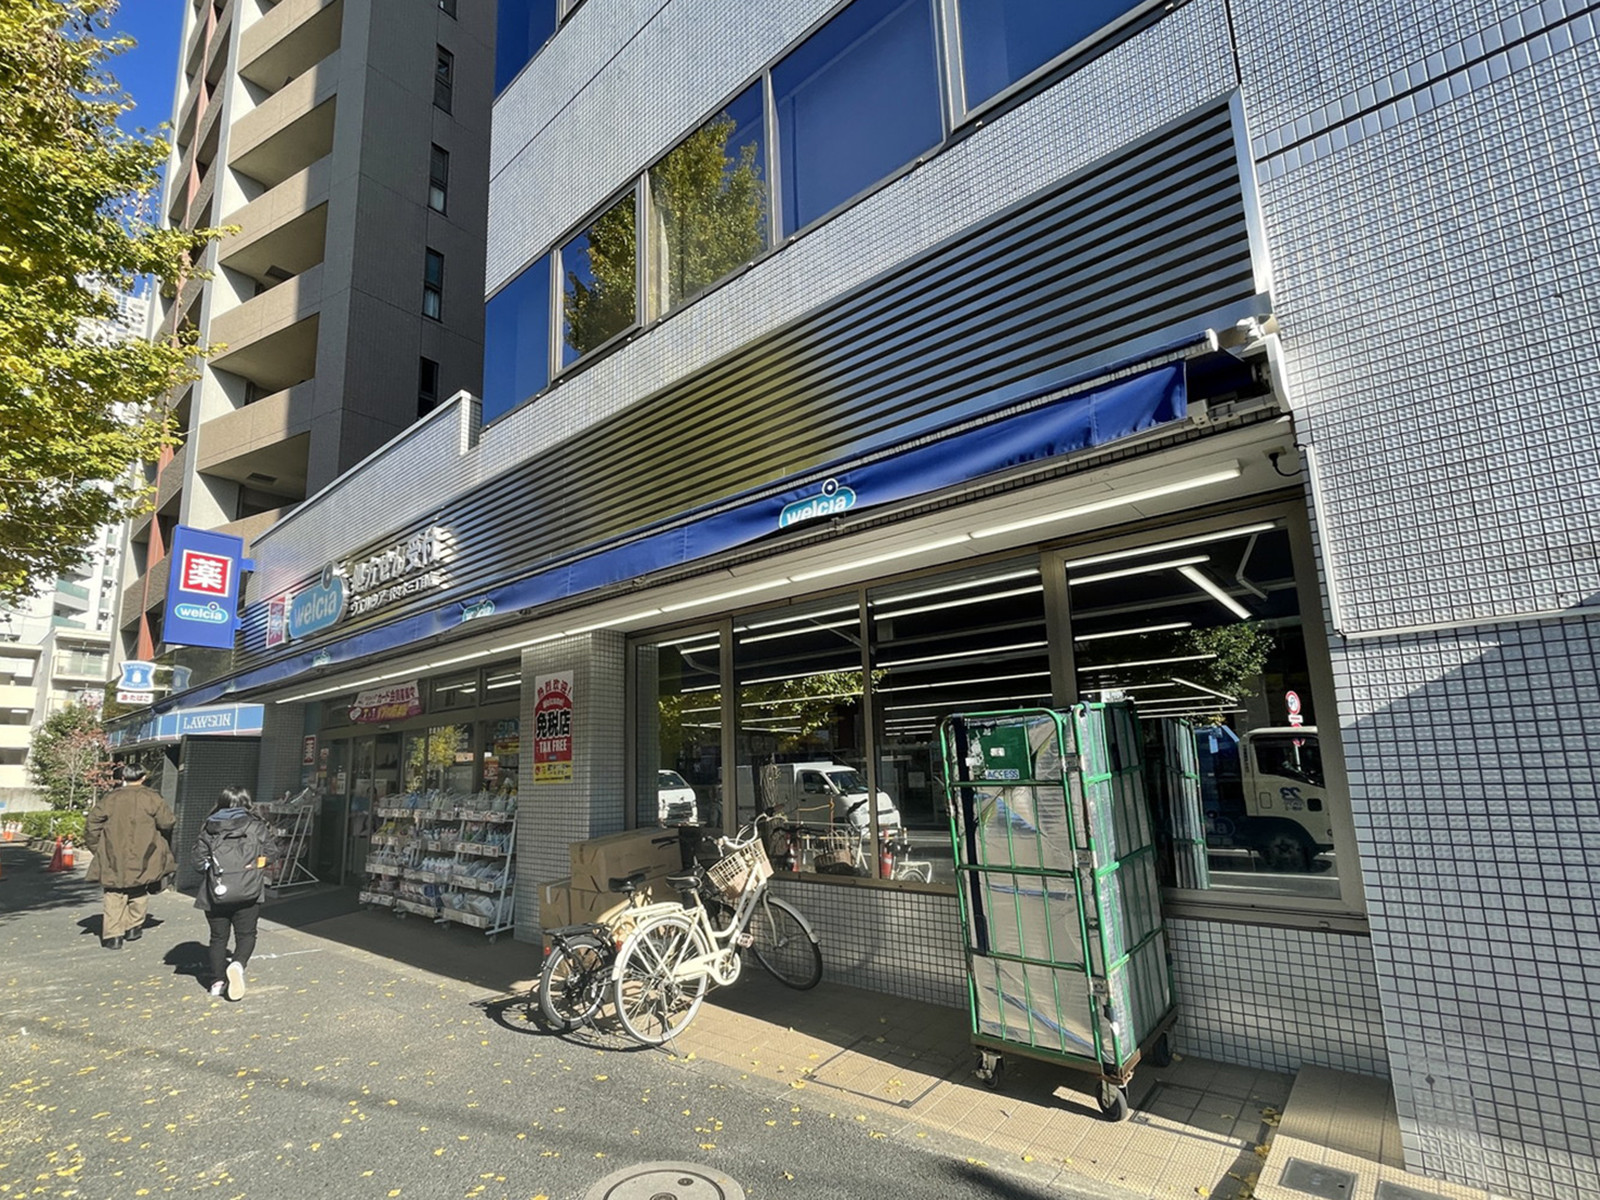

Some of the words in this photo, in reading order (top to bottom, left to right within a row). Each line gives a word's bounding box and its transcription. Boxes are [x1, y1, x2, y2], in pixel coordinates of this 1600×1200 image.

[786, 484, 847, 525] welcia
[188, 558, 223, 589] 薬
[179, 604, 223, 621] welcia
[293, 583, 338, 628] welcia
[183, 713, 231, 729] LAWSON
[537, 709, 571, 738] 免税店
[540, 741, 551, 753] TAX
[553, 739, 567, 752] FREE
[987, 770, 1018, 778] ACCESS
